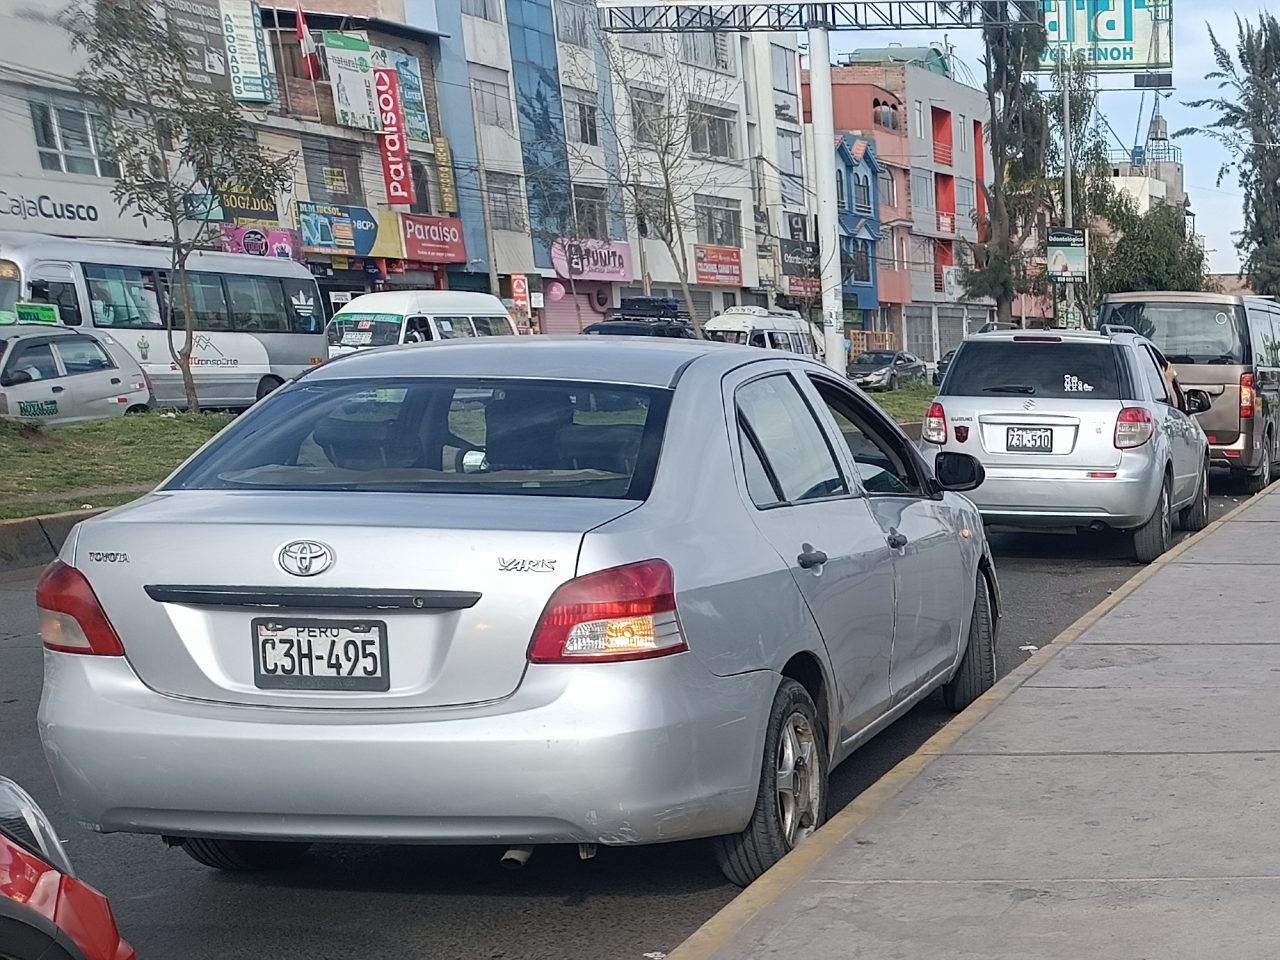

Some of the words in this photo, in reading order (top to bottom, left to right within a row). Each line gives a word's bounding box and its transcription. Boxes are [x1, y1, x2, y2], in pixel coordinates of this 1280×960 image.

[223, 13, 244, 95] ABOGADOS
[254, 4, 272, 101] ABOGADOS
[223, 194, 275, 212] BOGADOS
[88, 551, 130, 563] TOYOTA
[497, 556, 557, 572] YARIS
[261, 639, 379, 676] C3H-495
